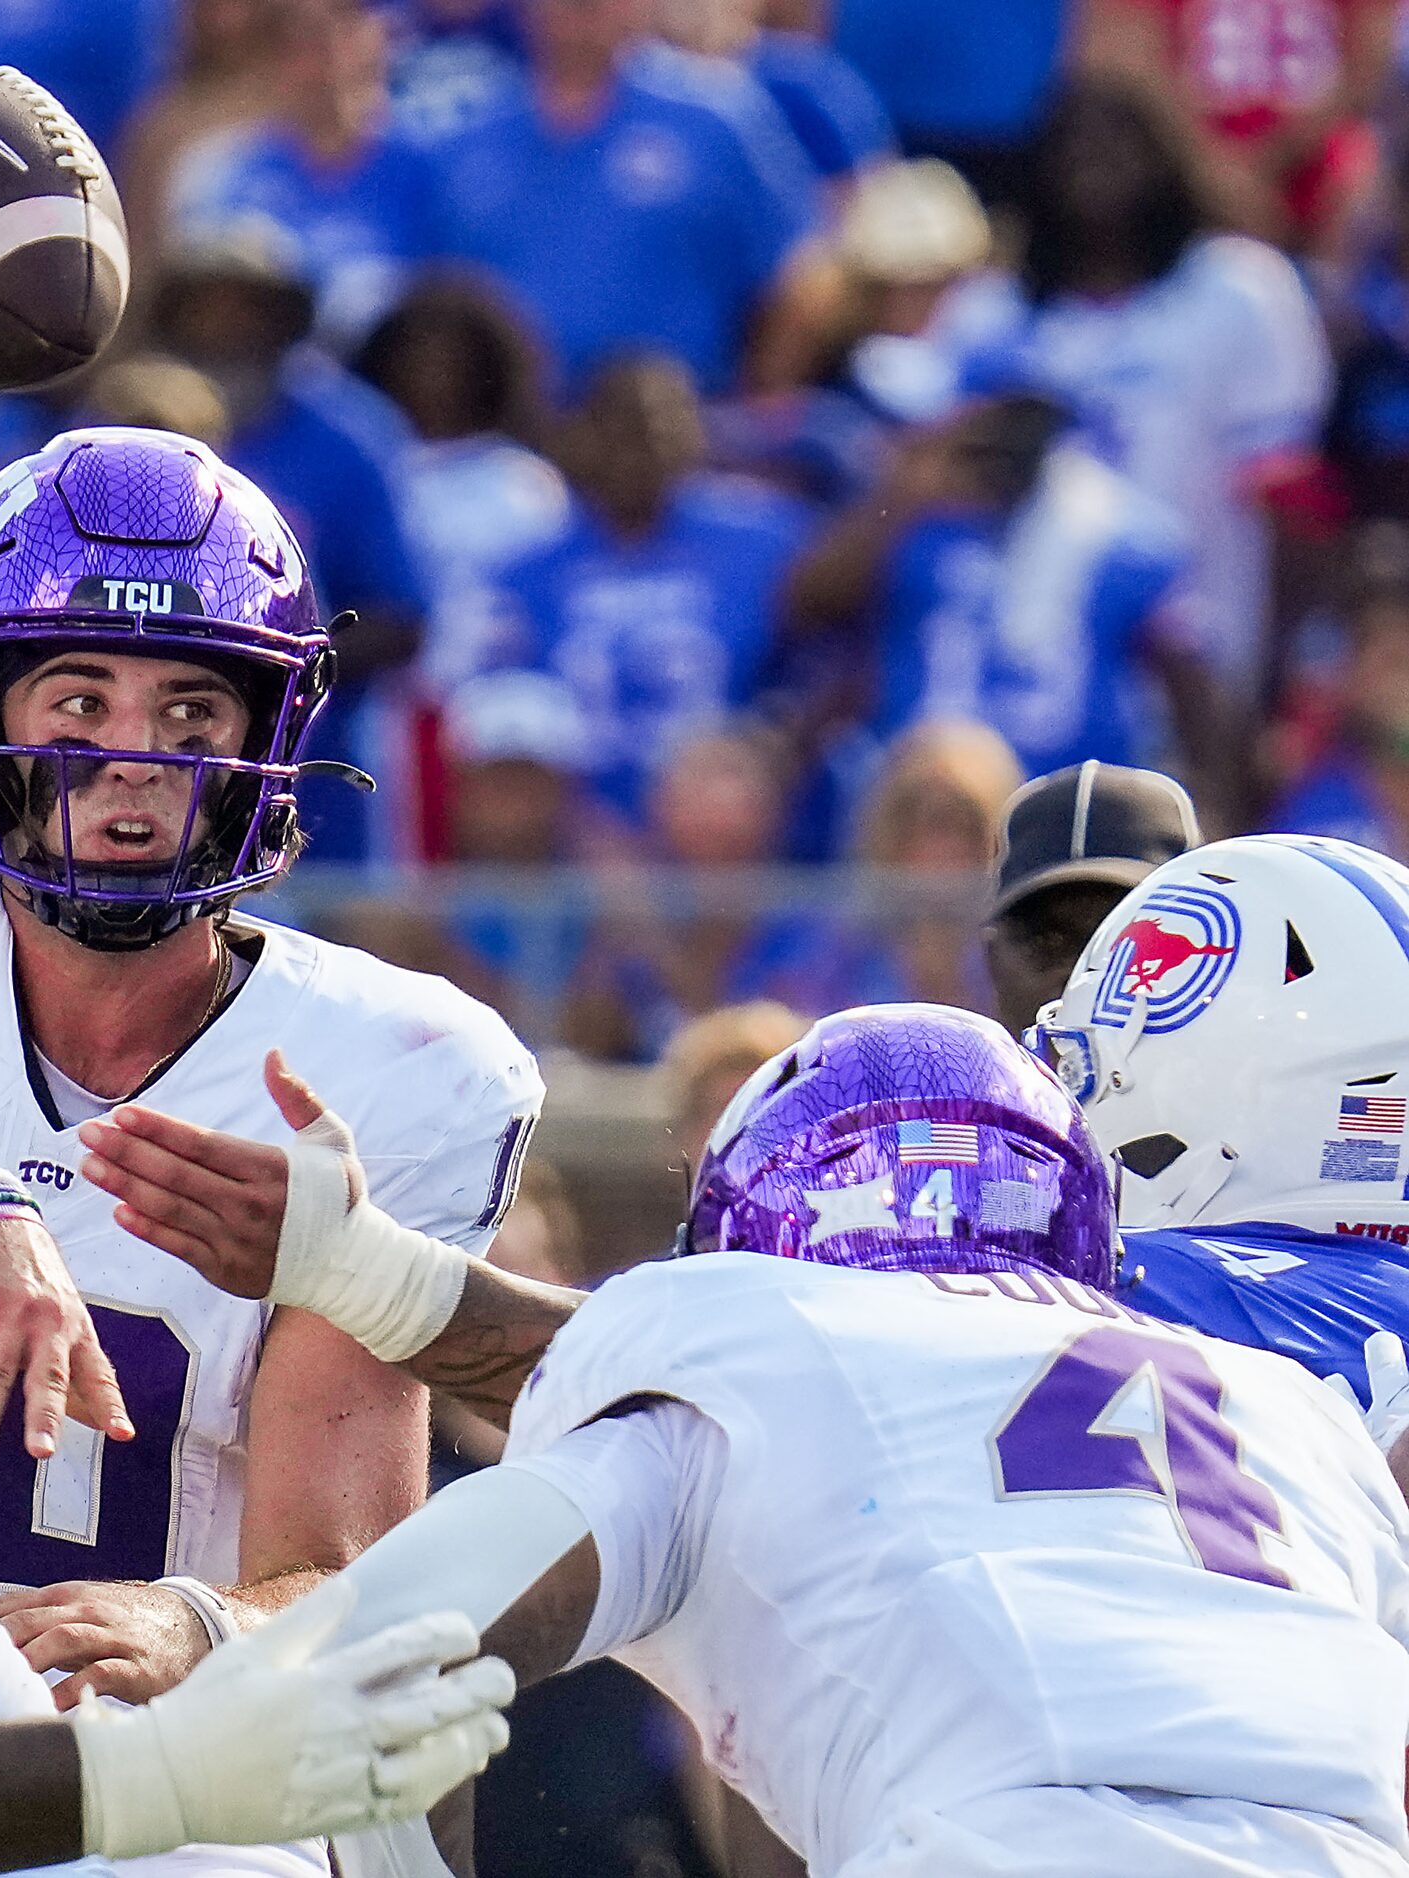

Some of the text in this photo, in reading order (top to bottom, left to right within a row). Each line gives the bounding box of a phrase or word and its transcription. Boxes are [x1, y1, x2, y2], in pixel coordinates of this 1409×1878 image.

[102, 580, 173, 614] TCU
[19, 1159, 75, 1192] TCU
[910, 1167, 958, 1238] 4
[987, 1326, 1298, 1593] 4
